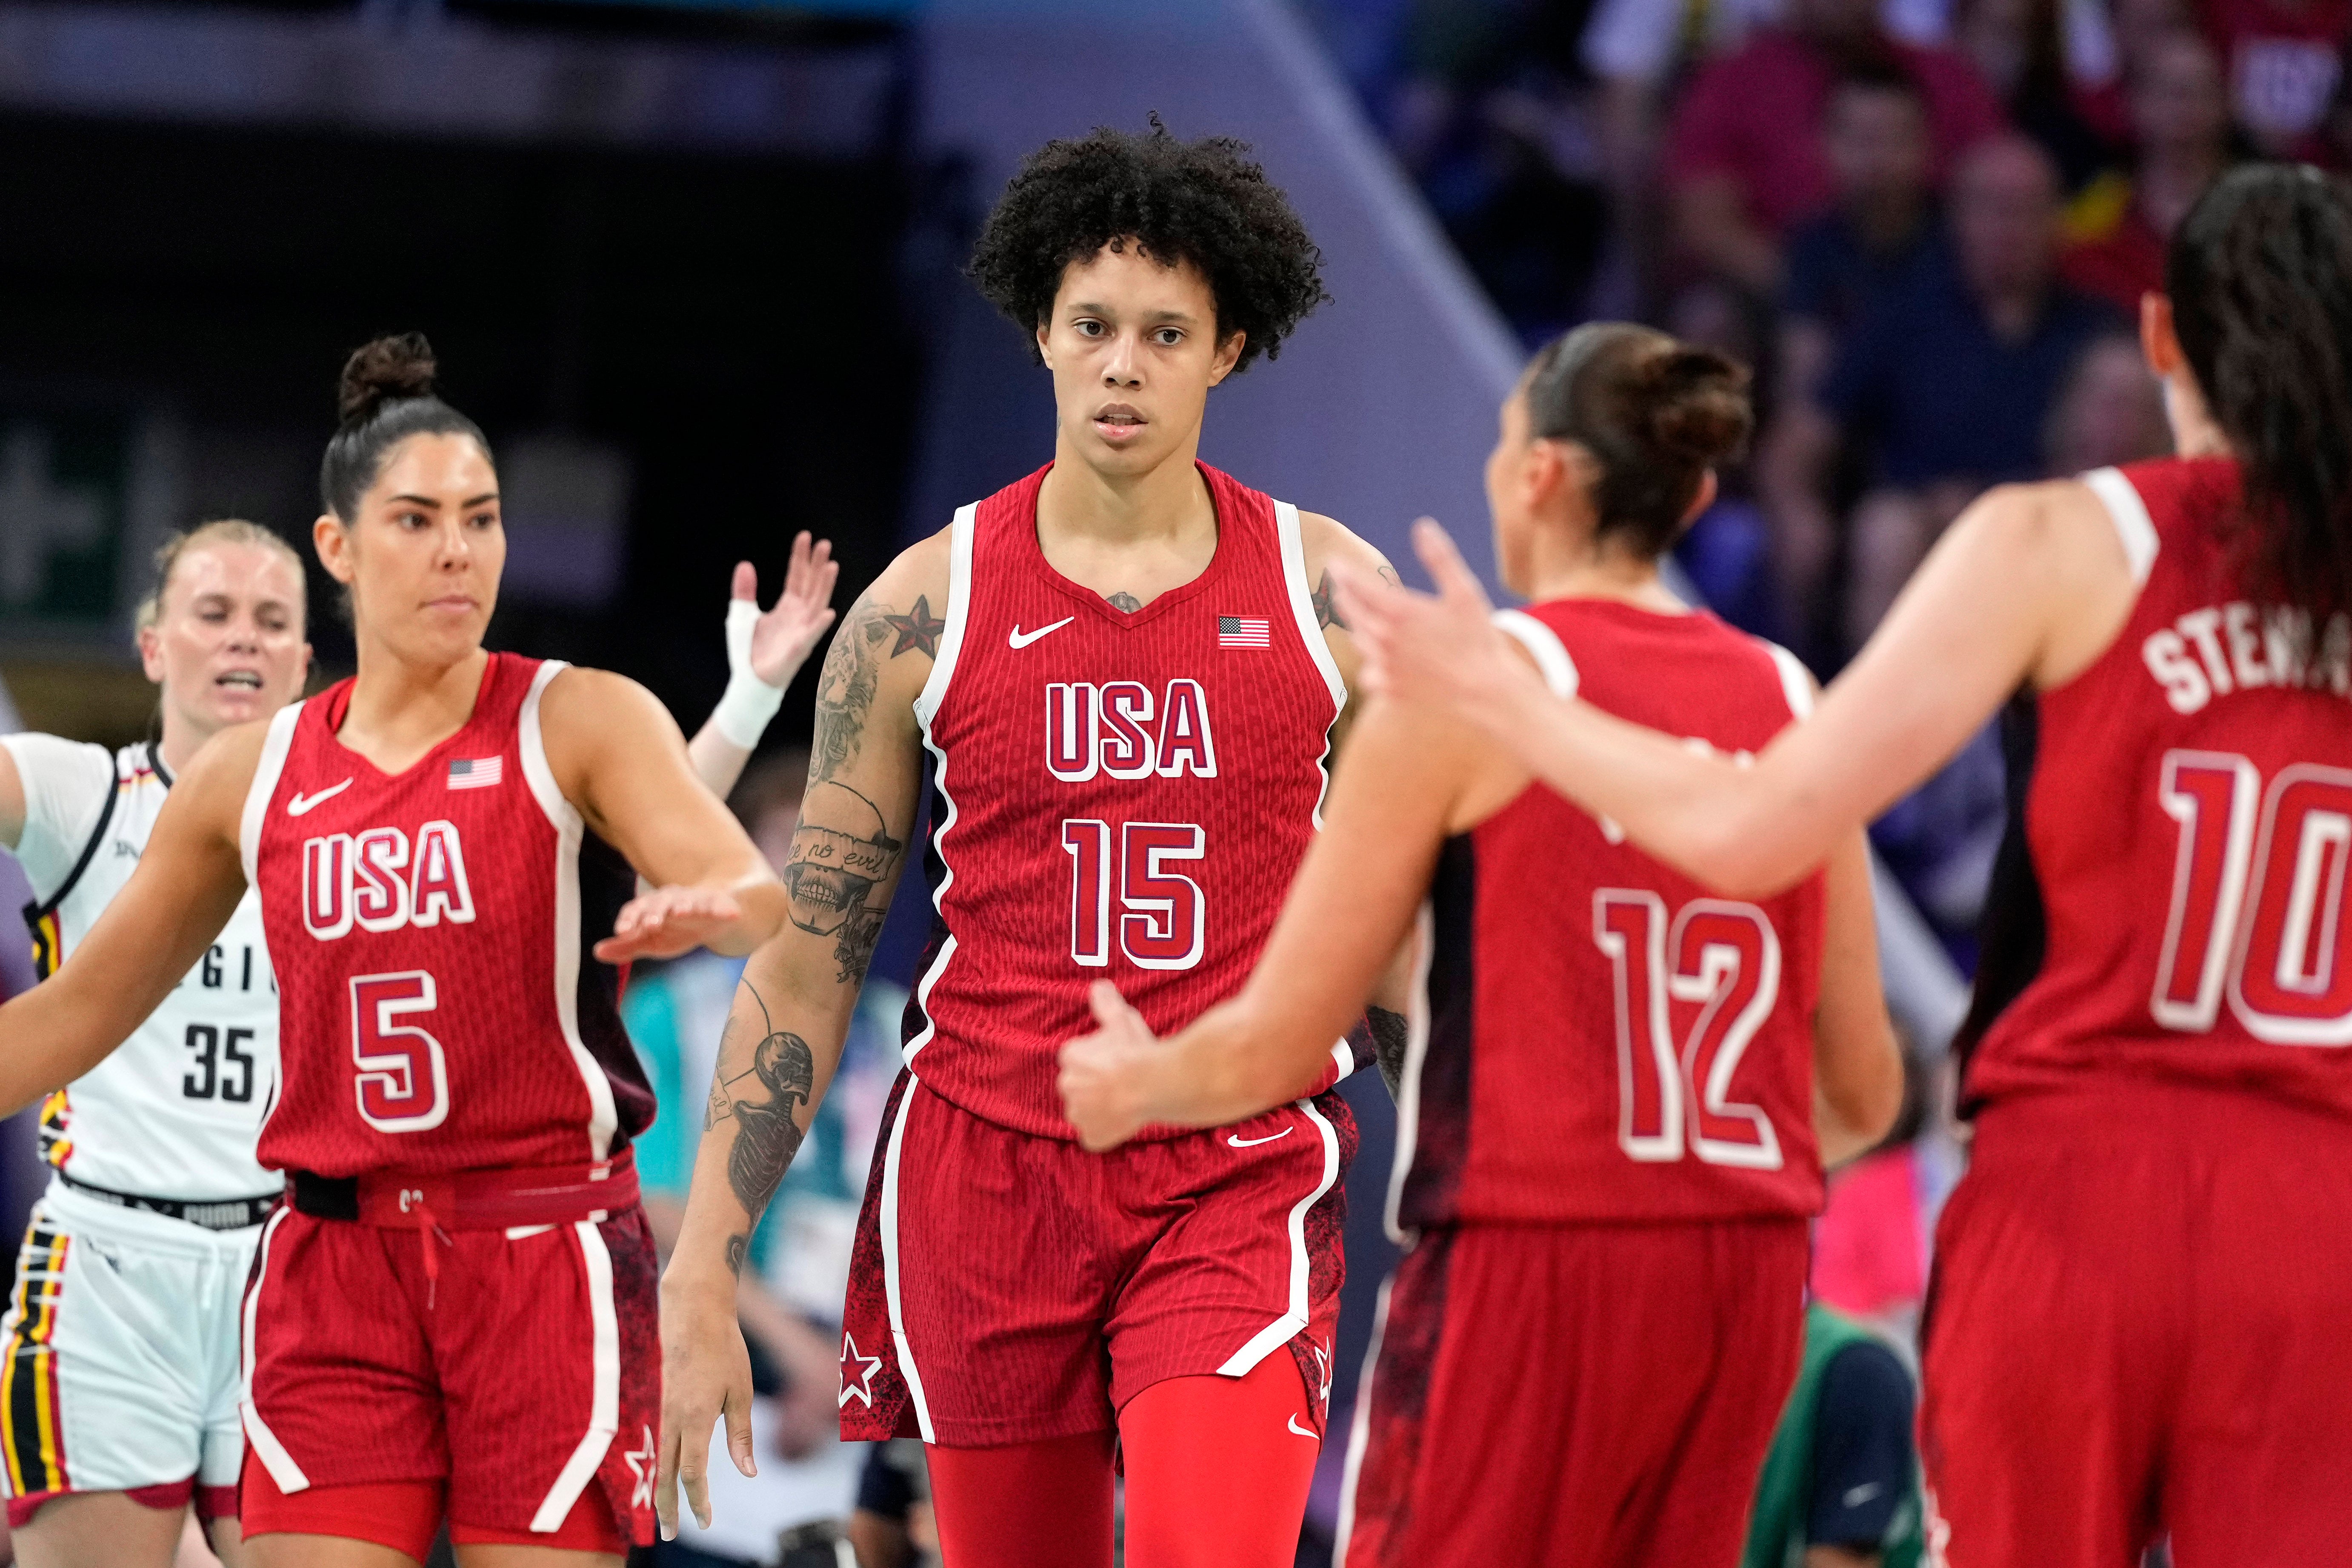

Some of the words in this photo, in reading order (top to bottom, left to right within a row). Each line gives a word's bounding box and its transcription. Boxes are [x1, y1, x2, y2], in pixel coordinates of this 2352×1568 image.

[2141, 599, 2352, 715] STEWA
[1046, 678, 1218, 782] USA
[302, 820, 476, 942] USA
[808, 843, 835, 858] no
[843, 852, 885, 873] evil
[1062, 819, 1206, 970] 15
[2148, 747, 2352, 1048] 10
[183, 1025, 254, 1103] 35
[349, 969, 450, 1133] 5
[1592, 887, 1784, 1169] 12
